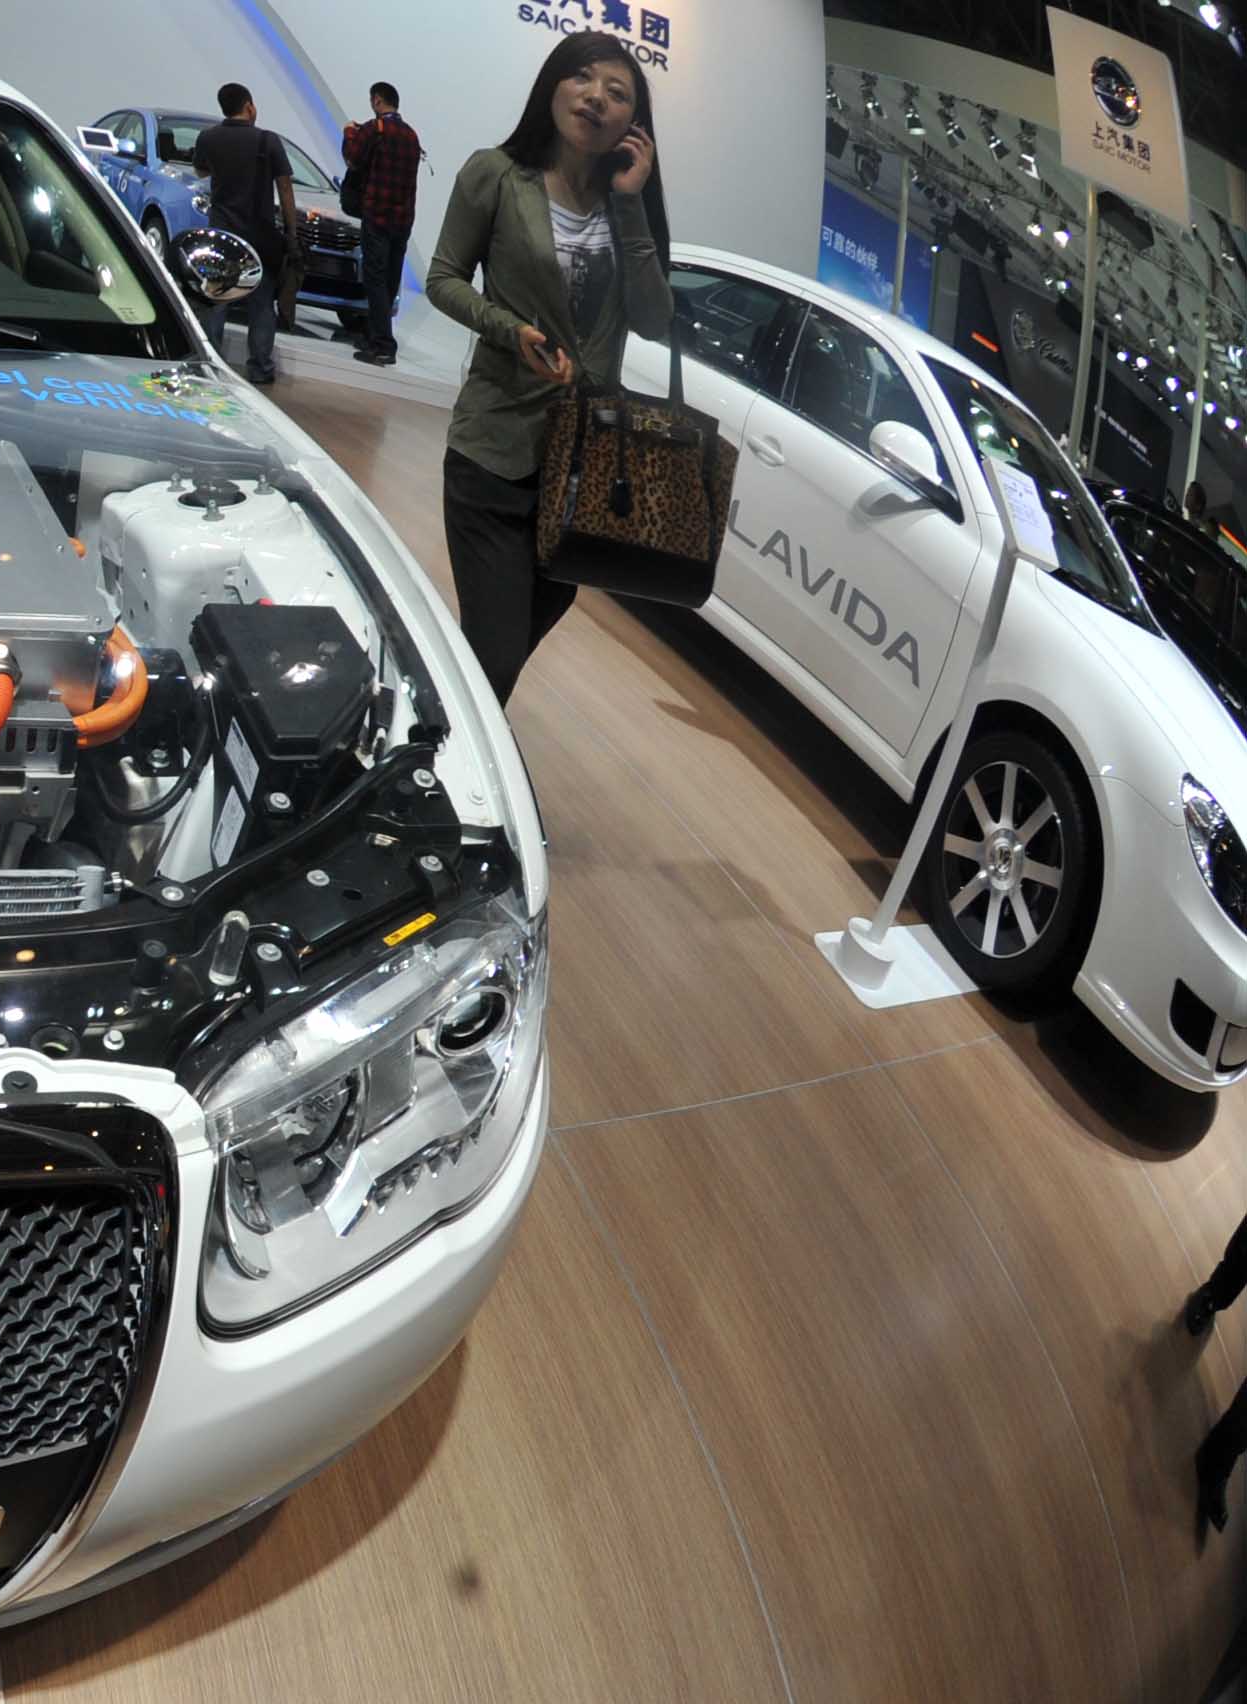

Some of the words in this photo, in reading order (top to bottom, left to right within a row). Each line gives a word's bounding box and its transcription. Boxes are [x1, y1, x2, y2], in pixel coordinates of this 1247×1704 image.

[518, 4, 576, 36] SAIC
[526, 0, 670, 49] 集团
[1093, 121, 1151, 161] 上汽集团
[42, 376, 134, 399] cell
[20, 388, 210, 427] vehicle
[727, 499, 920, 689] LAVIDA
